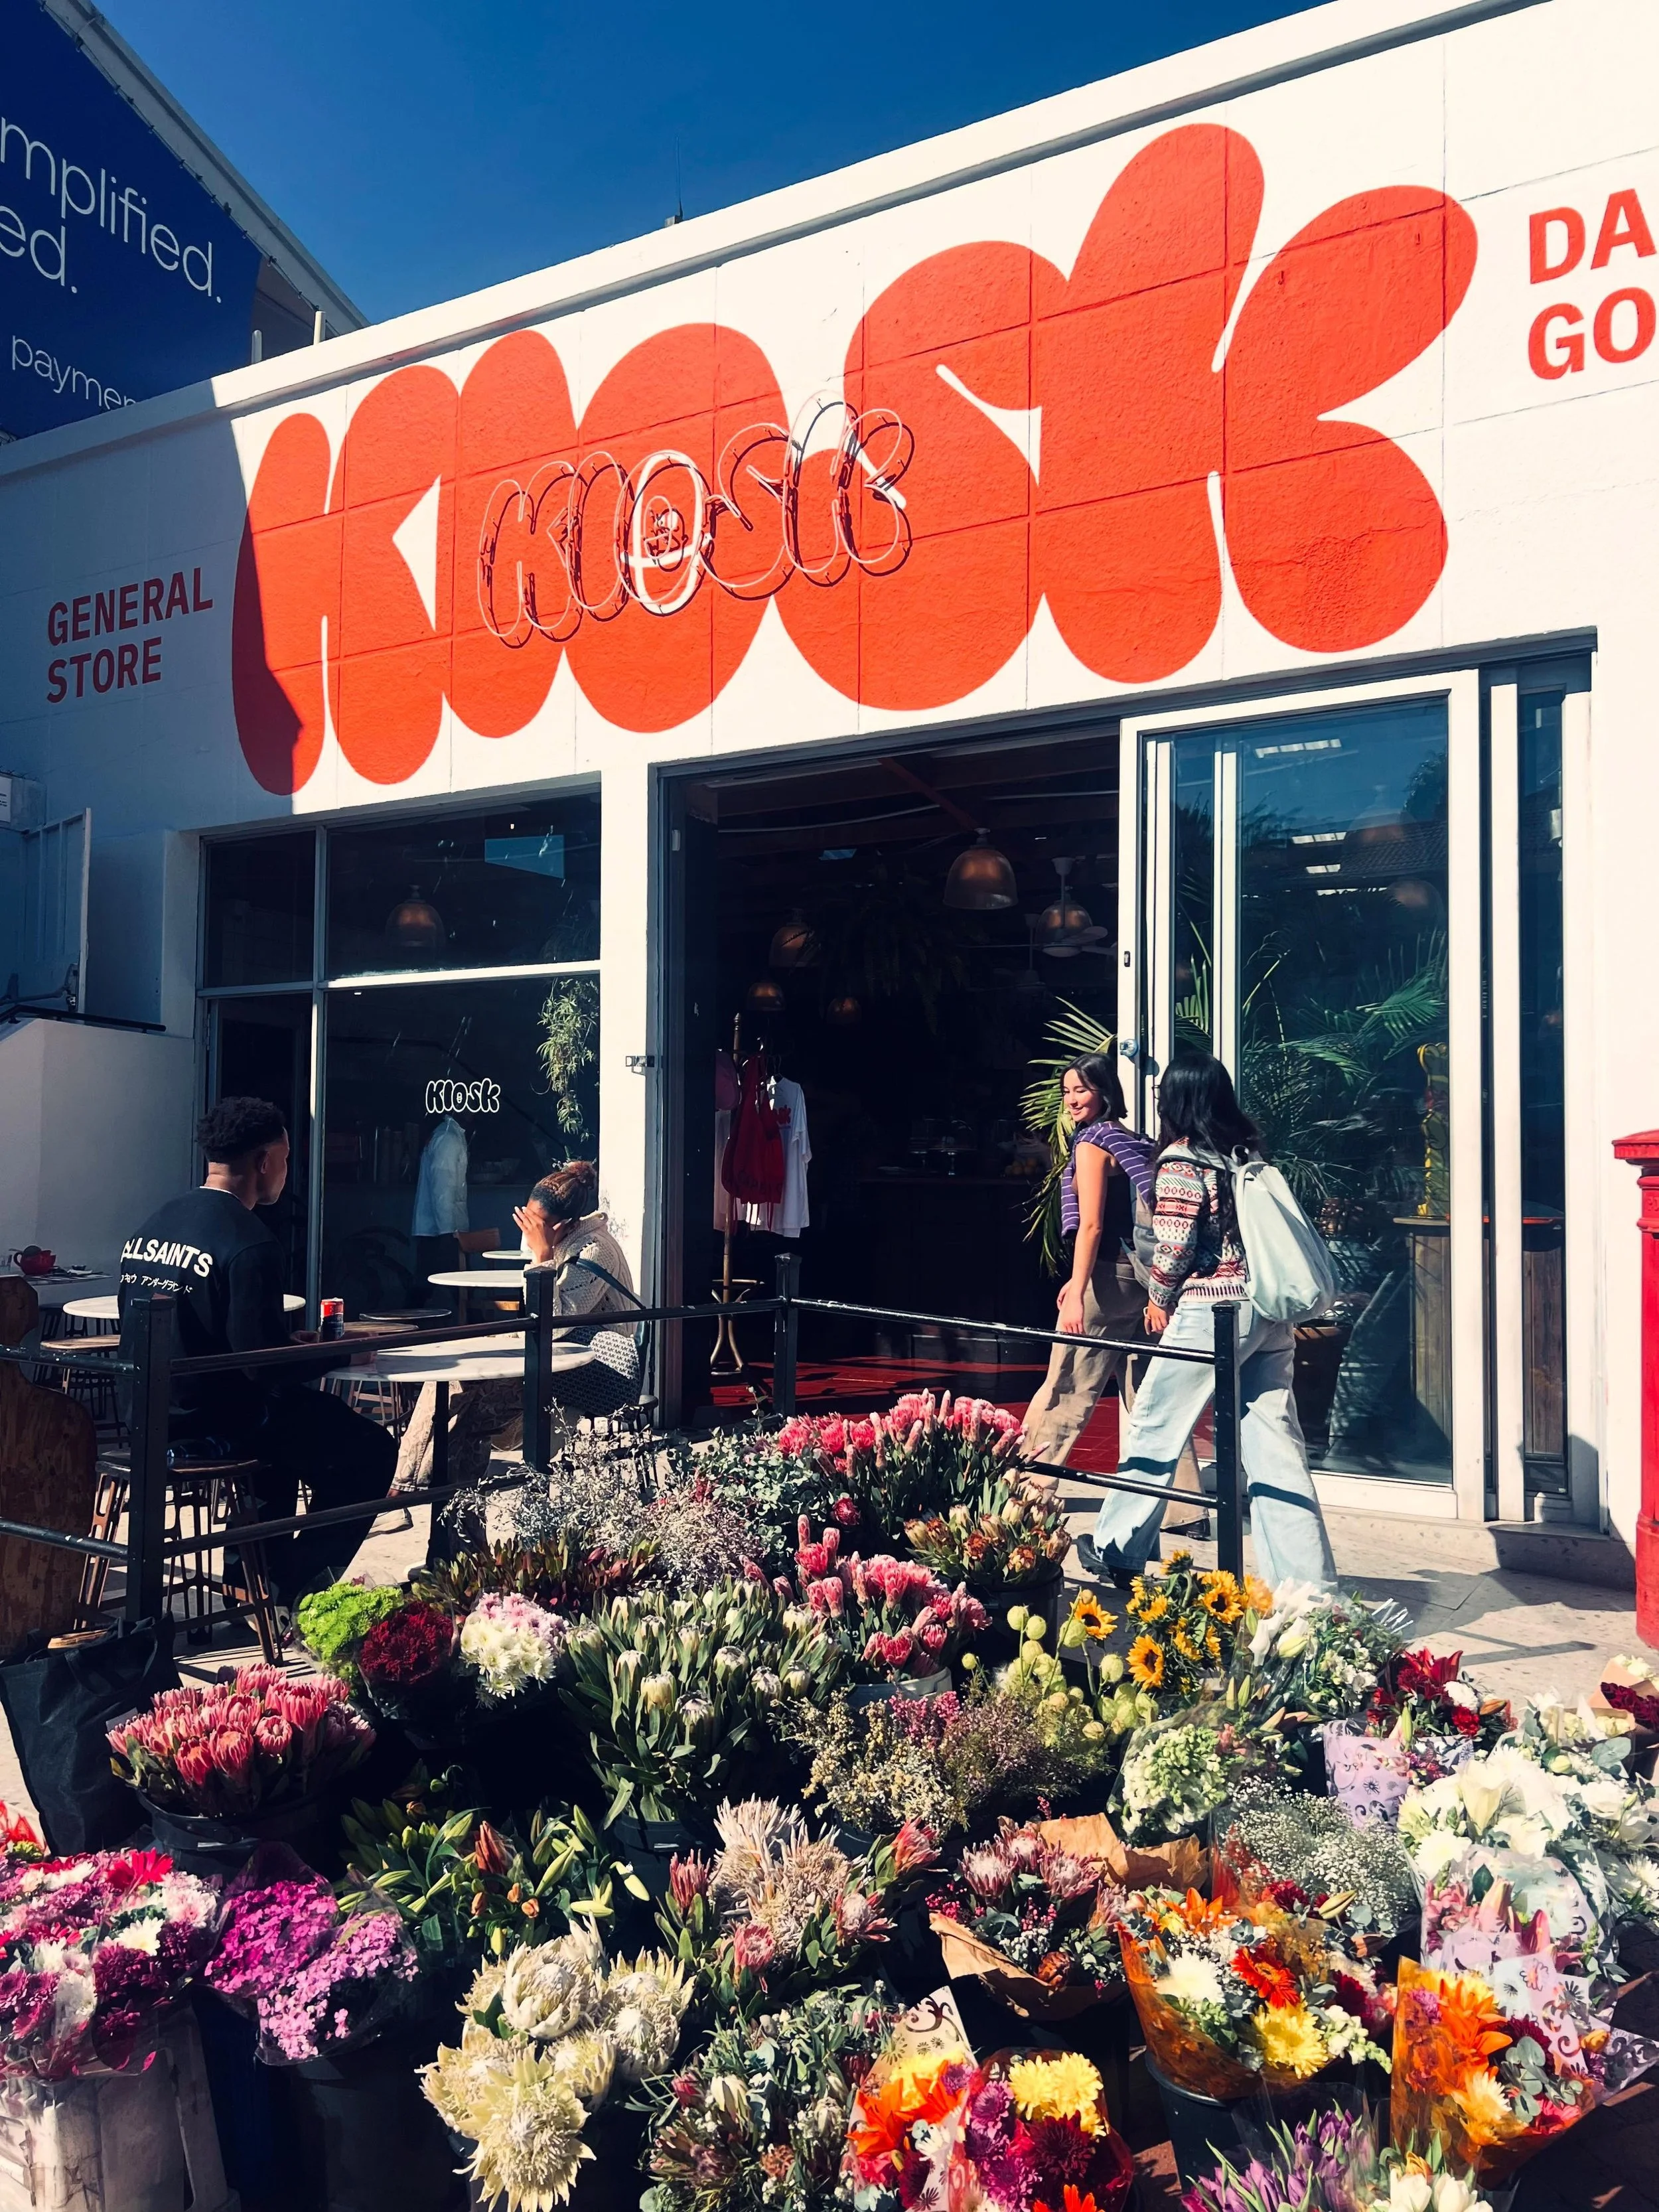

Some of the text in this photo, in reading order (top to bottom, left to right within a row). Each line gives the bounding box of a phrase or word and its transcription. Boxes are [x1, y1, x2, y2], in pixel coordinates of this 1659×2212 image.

[0, 117, 221, 303] mplified.
[1529, 188, 1657, 284] DA
[1528, 287, 1656, 380] GO
[48, 567, 213, 646] GENERAL
[46, 636, 161, 703] STORE
